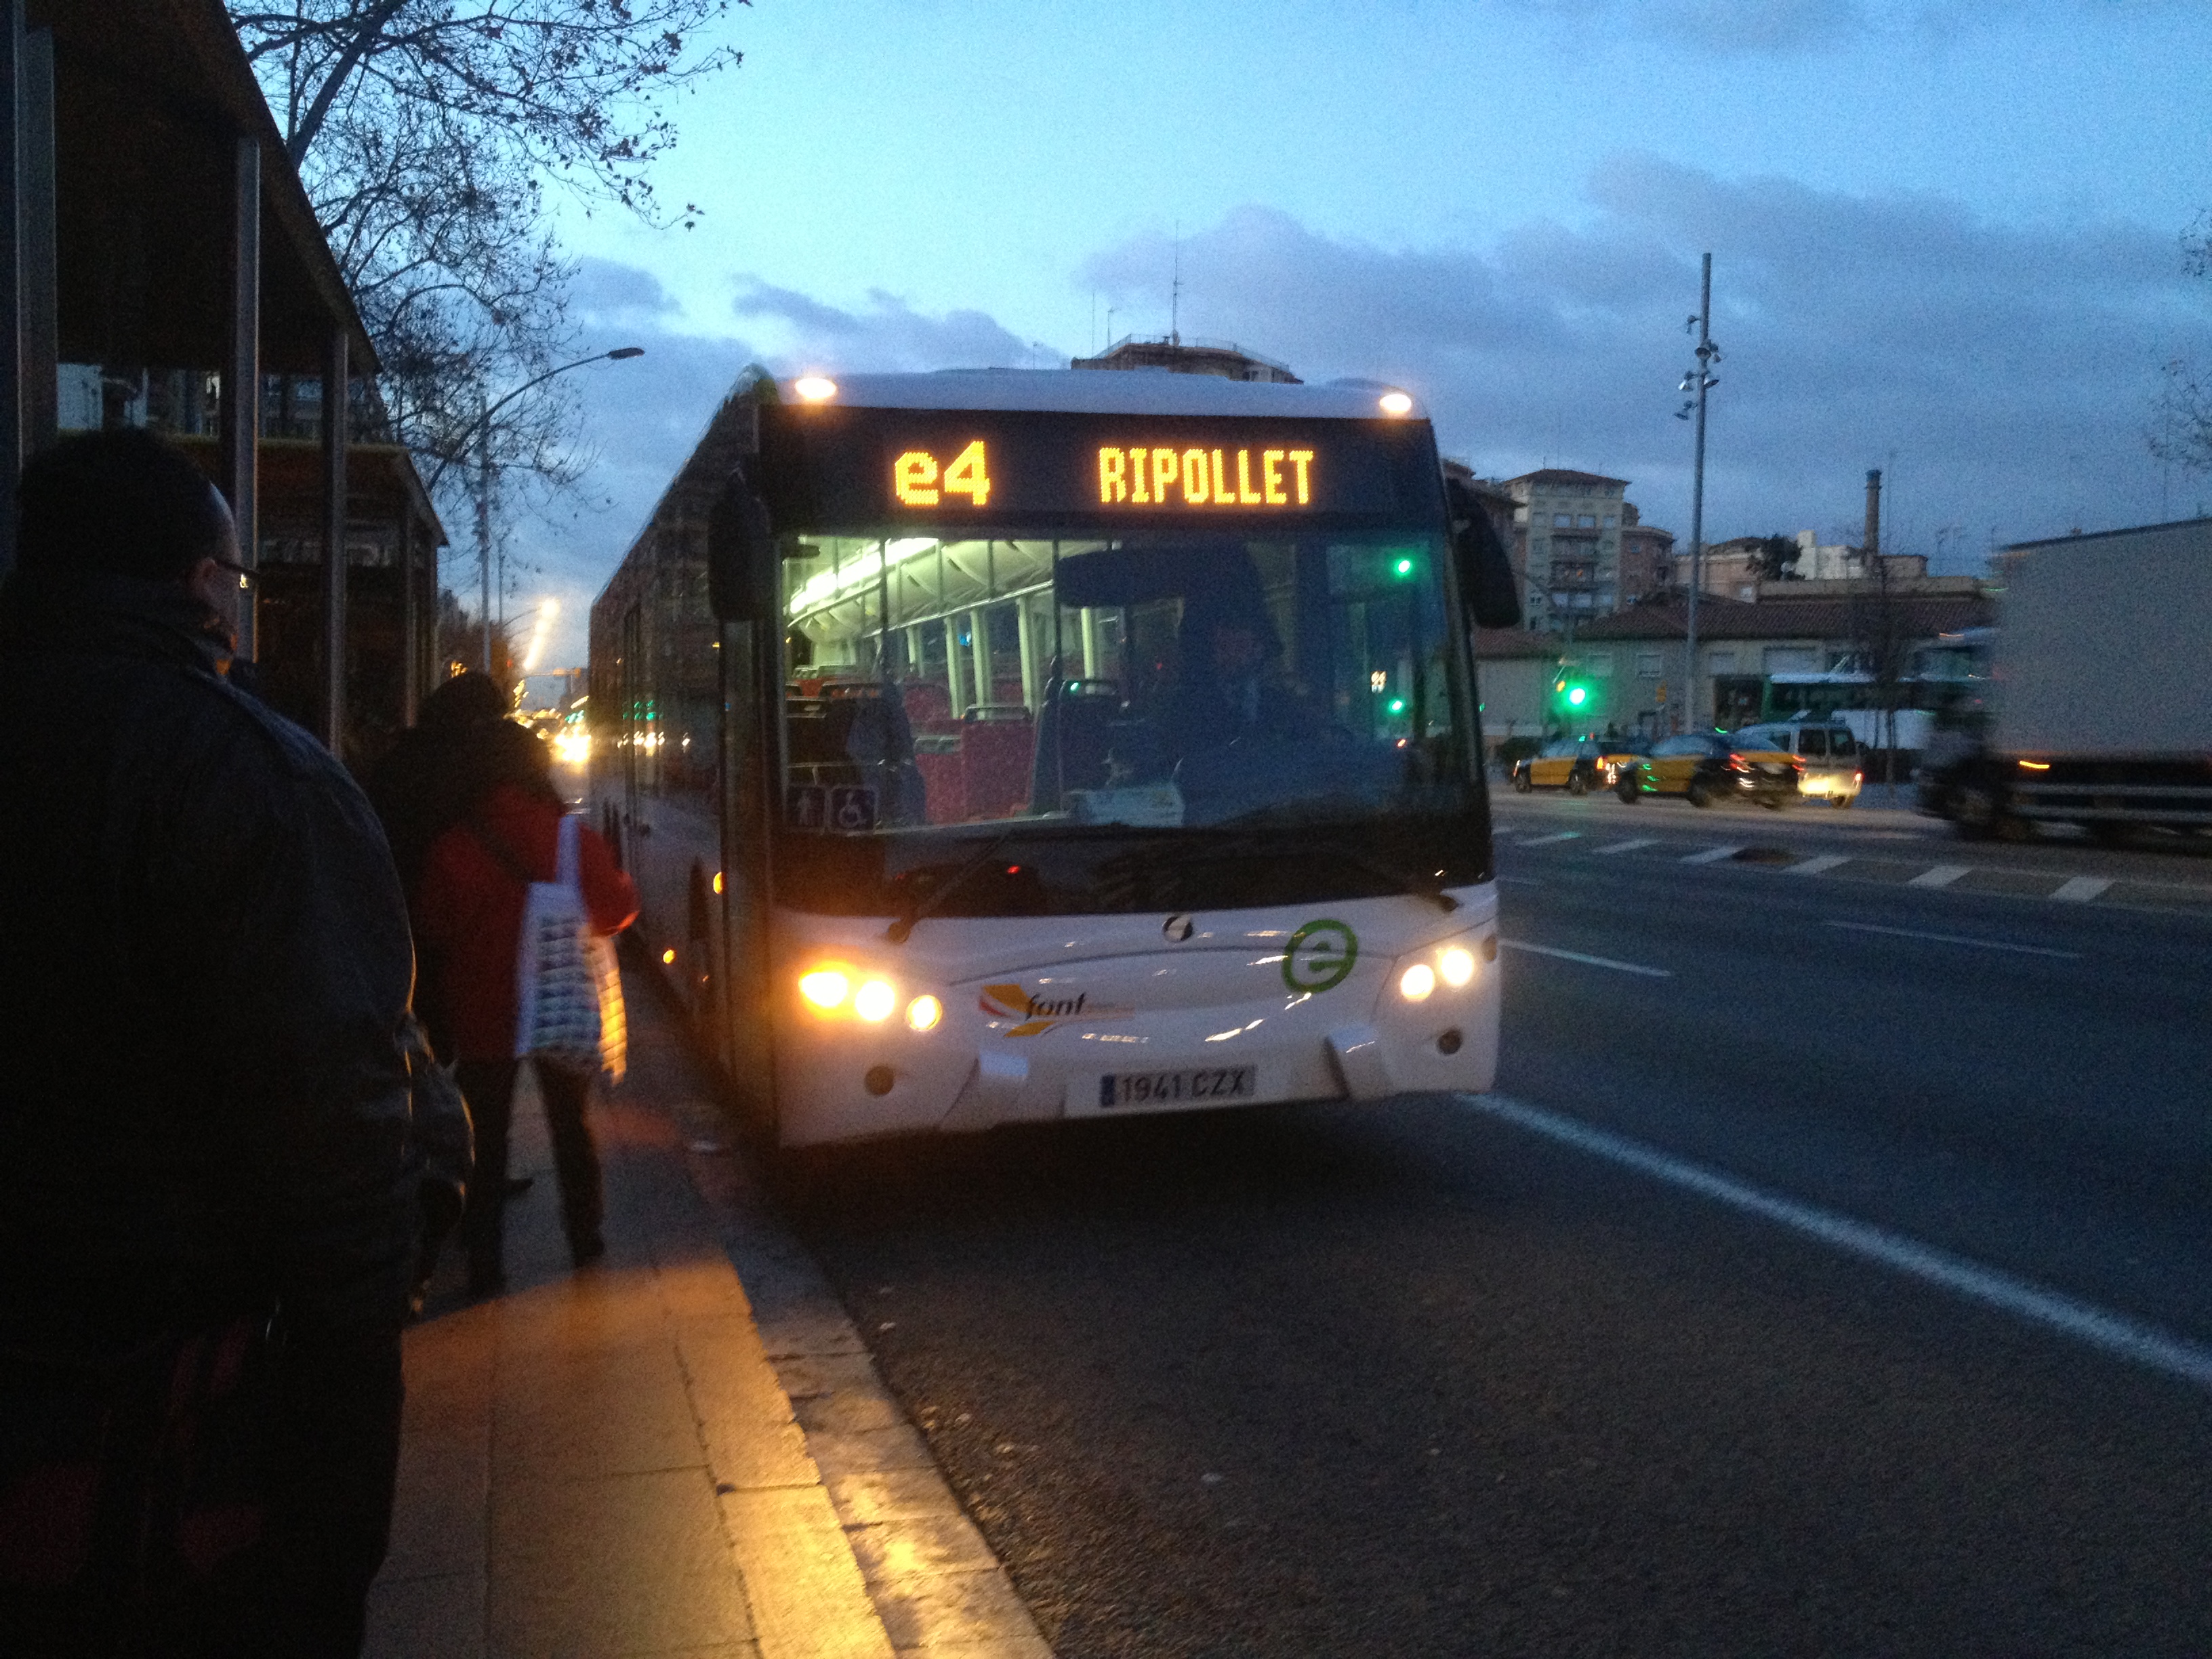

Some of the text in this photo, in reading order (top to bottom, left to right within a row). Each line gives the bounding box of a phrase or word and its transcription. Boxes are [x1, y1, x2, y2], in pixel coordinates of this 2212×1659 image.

[894, 440, 1314, 506] e4 RIPOLLET
[1122, 1068, 1246, 1103] 1941 CZX
